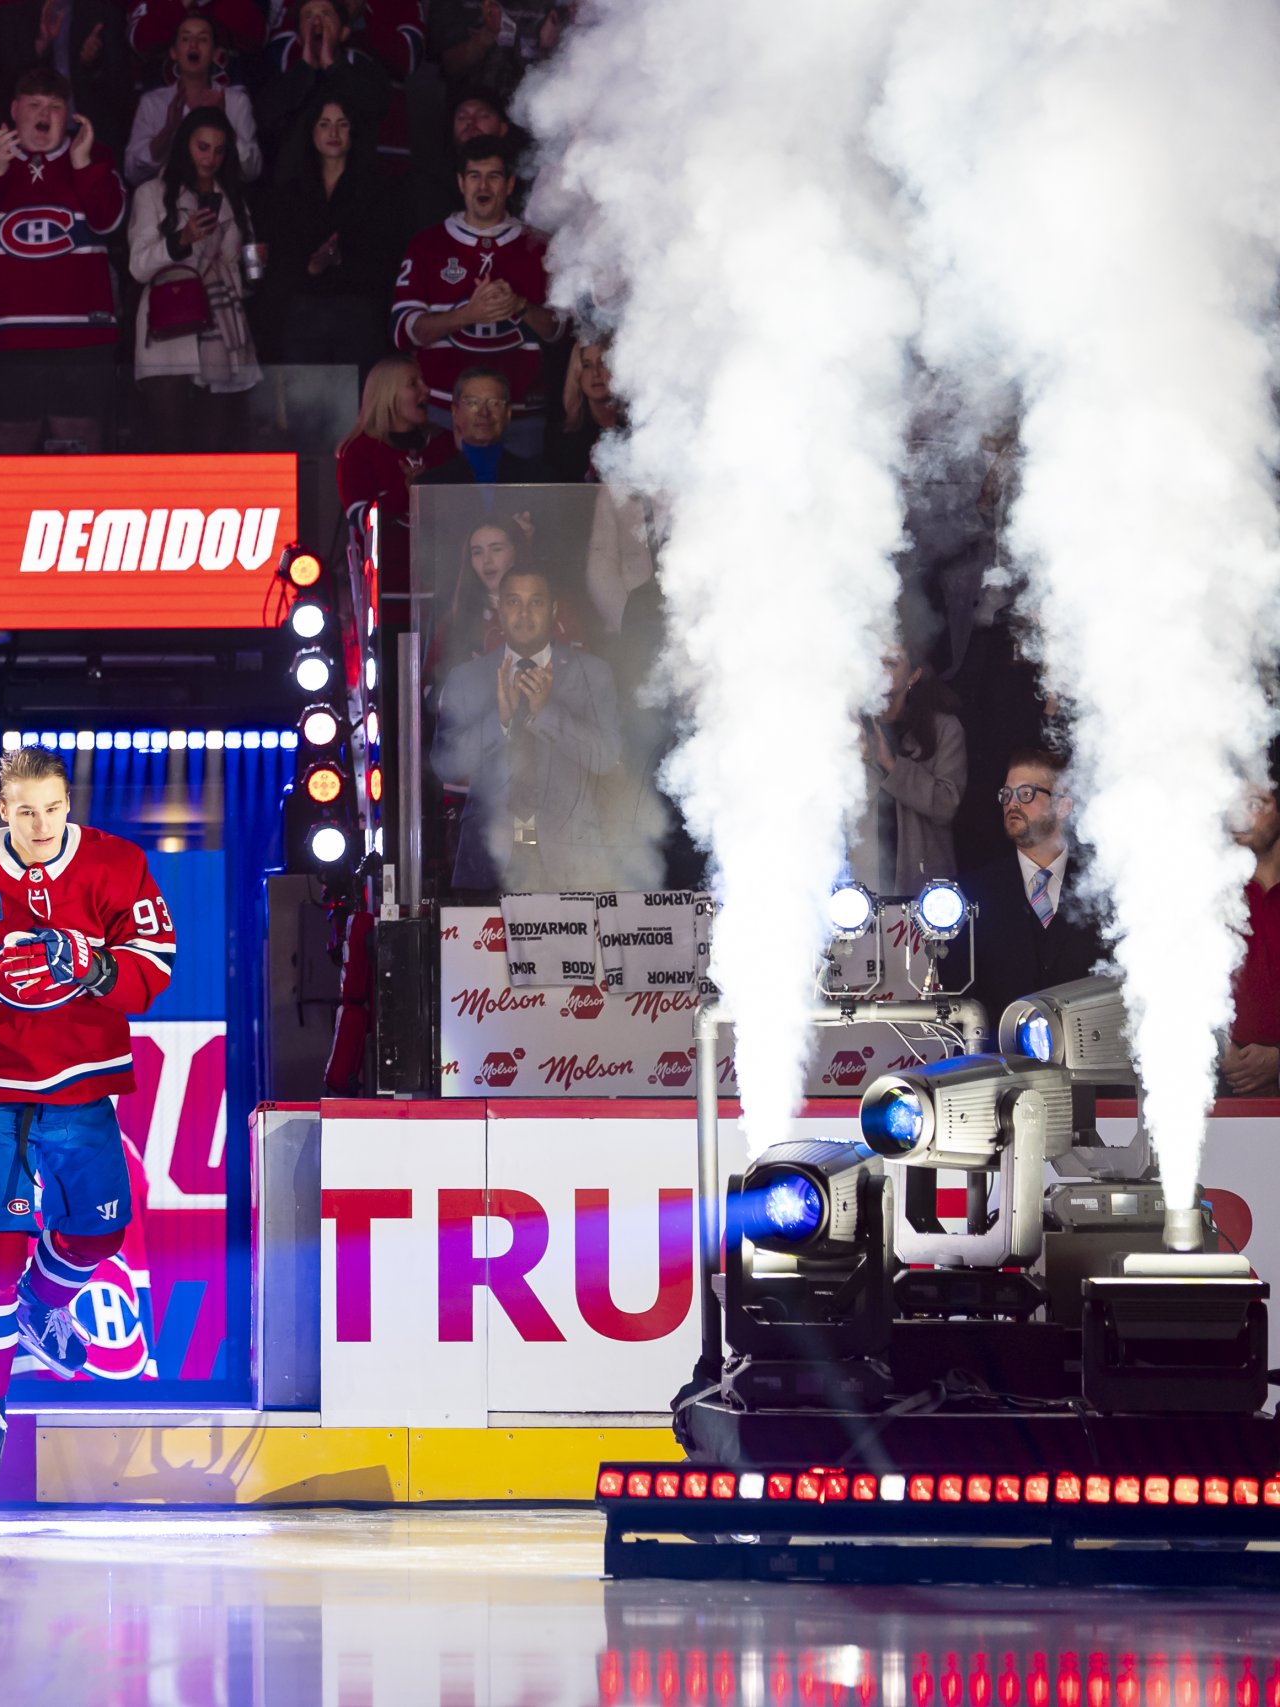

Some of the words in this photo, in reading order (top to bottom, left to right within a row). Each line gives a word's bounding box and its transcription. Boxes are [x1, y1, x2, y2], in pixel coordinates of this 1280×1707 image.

[20, 508, 280, 572] DEMIDOV
[132, 895, 174, 937] 93
[508, 922, 588, 936] BODYARMOR
[601, 931, 674, 948] BODYARMO
[451, 987, 545, 1024] Molson
[538, 1054, 634, 1091] Molson
